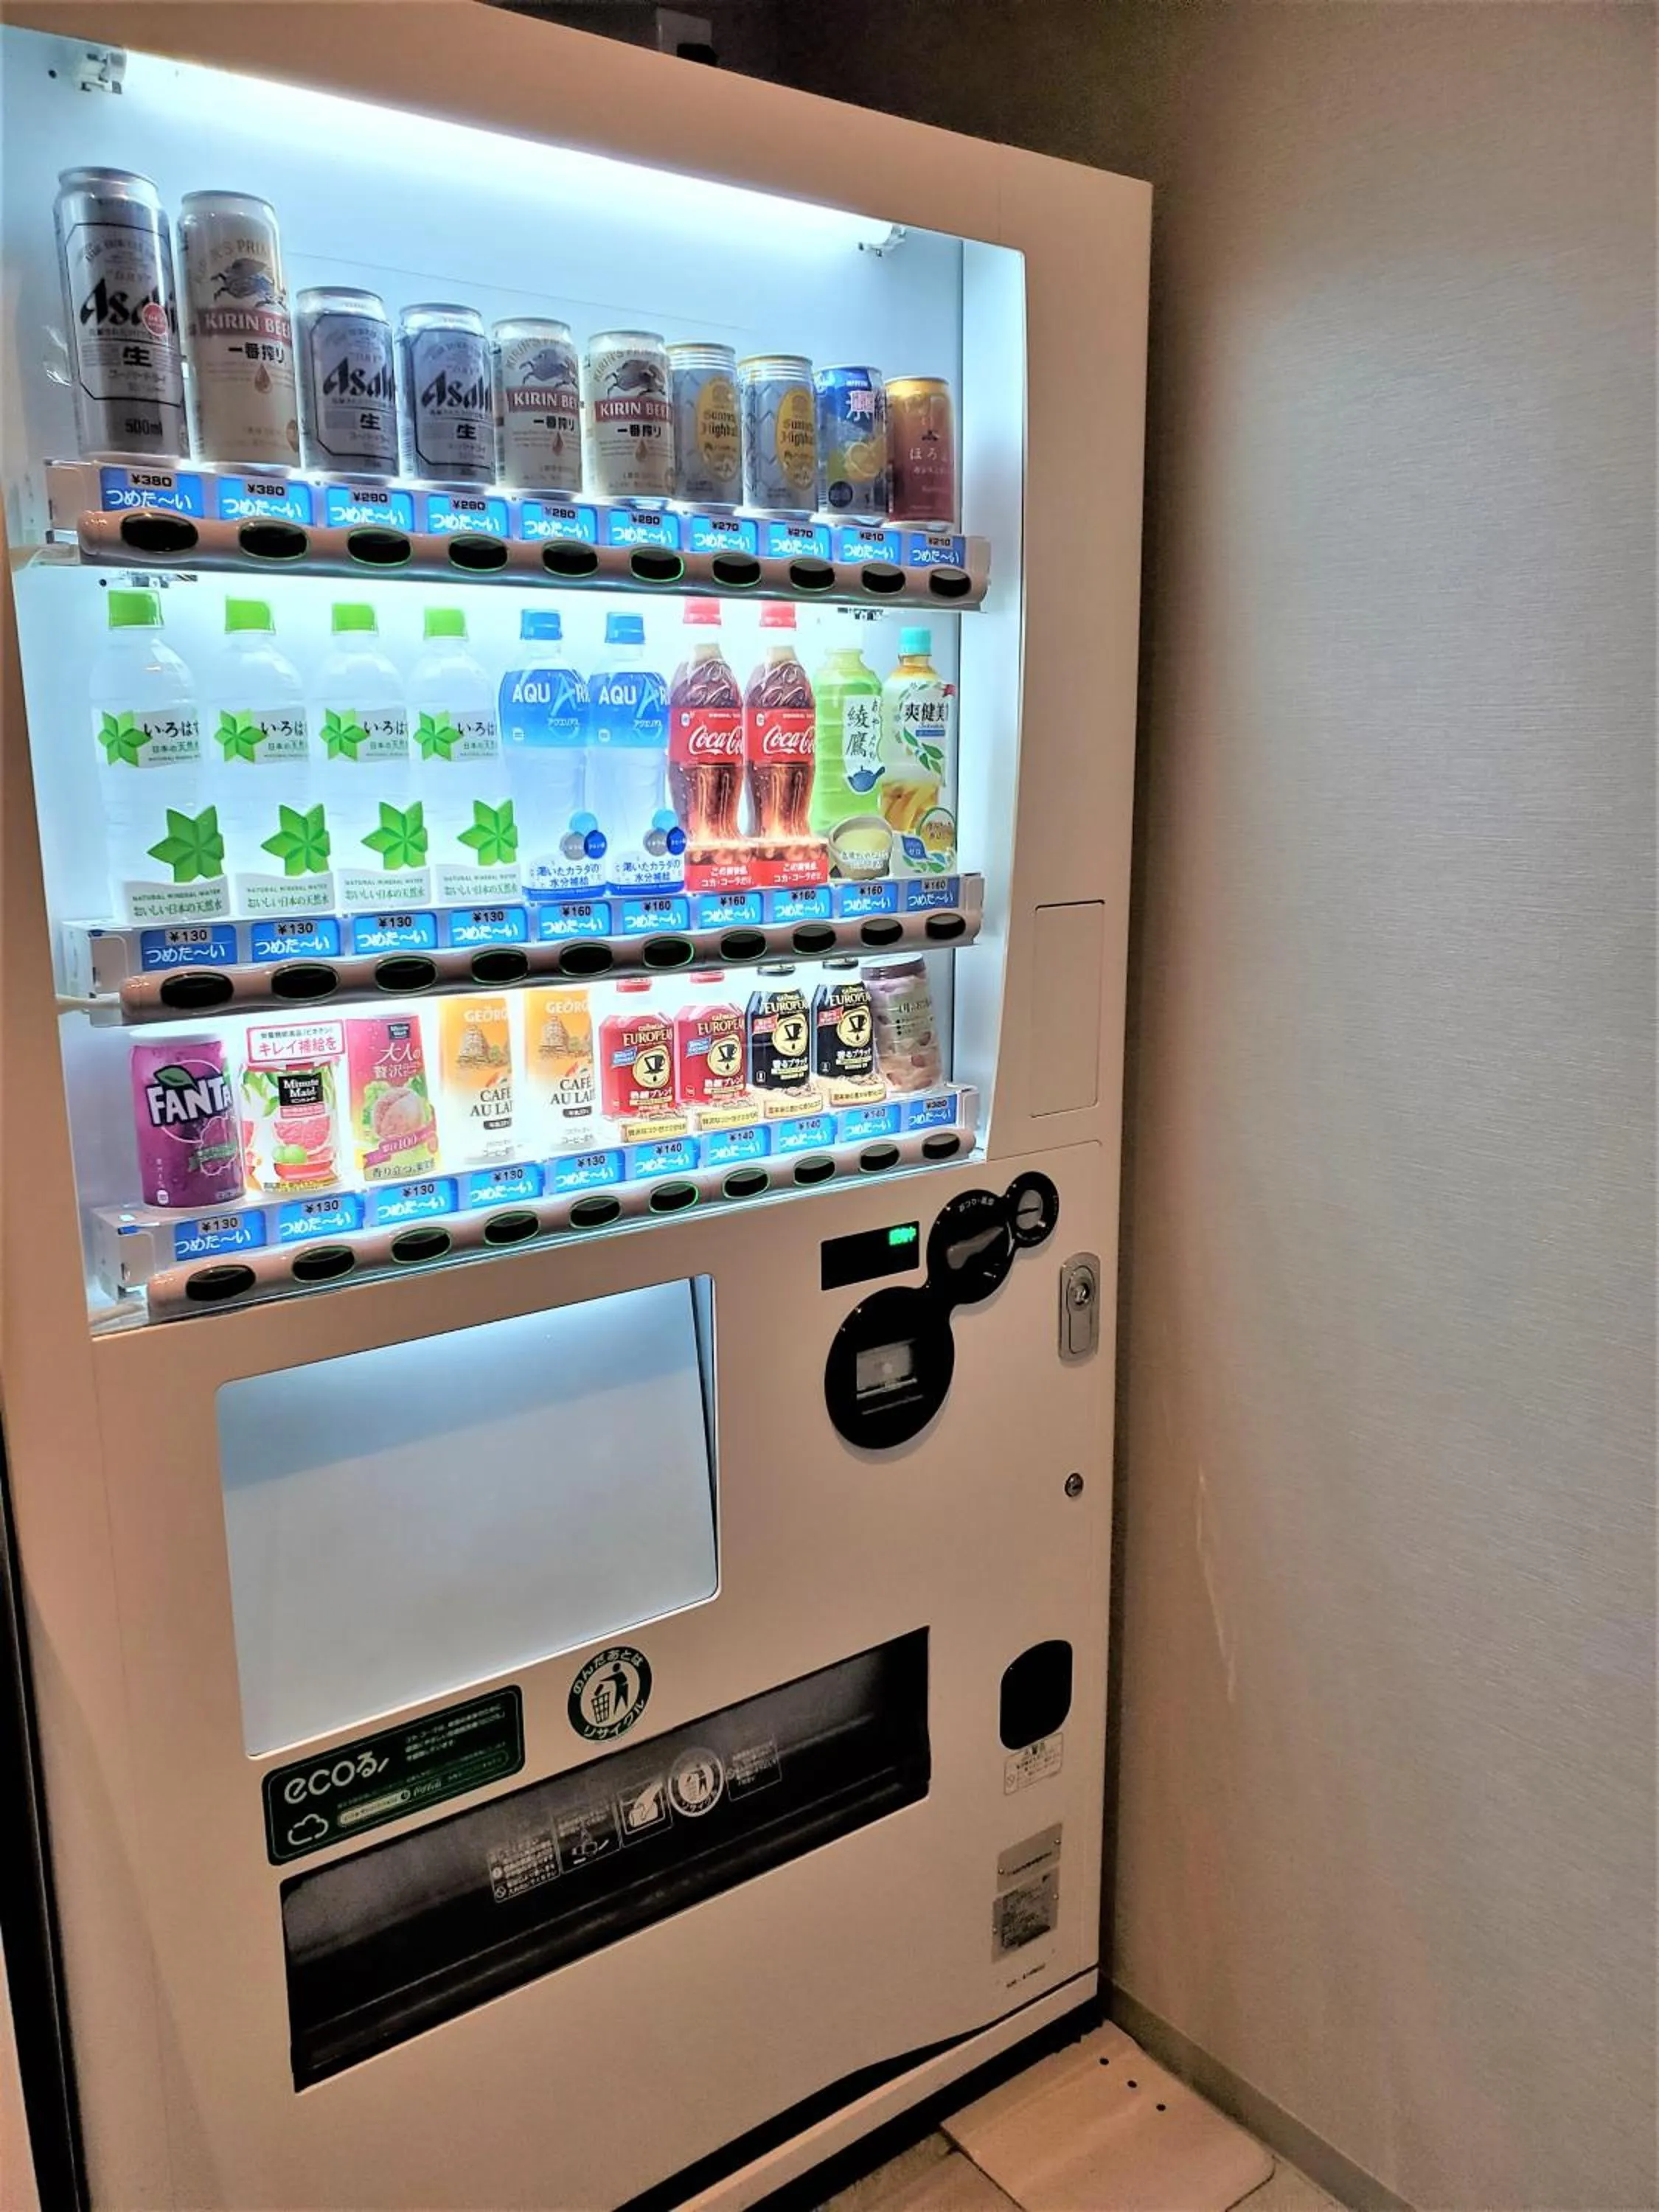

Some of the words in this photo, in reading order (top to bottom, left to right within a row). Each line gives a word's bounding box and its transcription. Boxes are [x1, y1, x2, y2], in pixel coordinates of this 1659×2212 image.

[205, 313, 259, 331] KIRIN
[123, 345, 153, 367] 生
[228, 343, 286, 363] 一番搾り
[514, 392, 557, 406] KIRIN
[600, 402, 641, 417] KIRIN
[125, 417, 164, 437] 500ml
[360, 413, 381, 430] 生
[533, 416, 574, 431] 一番搾り
[456, 424, 477, 440] 生
[617, 424, 661, 439] 一番搾り
[131, 473, 173, 487] ¥380
[247, 483, 286, 496] ¥380
[353, 492, 387, 503] ¥280
[453, 500, 486, 511] ¥280
[544, 507, 576, 519] ¥280
[632, 515, 660, 526] ¥280
[712, 521, 740, 532] ¥270
[788, 527, 813, 538] ¥270
[860, 532, 884, 542] ¥210
[929, 538, 950, 547] ¥210
[905, 702, 949, 722] 爽健美
[261, 720, 307, 737] いろは
[364, 721, 408, 736] いろは
[846, 703, 871, 757] 綾鷹
[721, 896, 745, 906] ¥160
[473, 911, 504, 922] ¥130
[563, 906, 591, 917] ¥160
[278, 922, 313, 935] ¥130
[378, 917, 412, 928] ¥130
[170, 930, 207, 942] ¥130
[283, 1078, 319, 1089] Minute
[290, 1086, 317, 1098] Maid
[550, 1093, 572, 1106] AU
[470, 1105, 493, 1118] AU
[495, 1100, 513, 1115] LA
[730, 1130, 754, 1142] ¥140
[655, 1144, 682, 1155] ¥140
[577, 1155, 605, 1168] ¥130
[495, 1169, 524, 1181] ¥130
[403, 1184, 435, 1197] ¥130
[305, 1200, 339, 1214] ¥130
[201, 1217, 238, 1232] ¥130
[573, 1649, 644, 1695] のんだあとは
[584, 1699, 645, 1739] リサイクル
